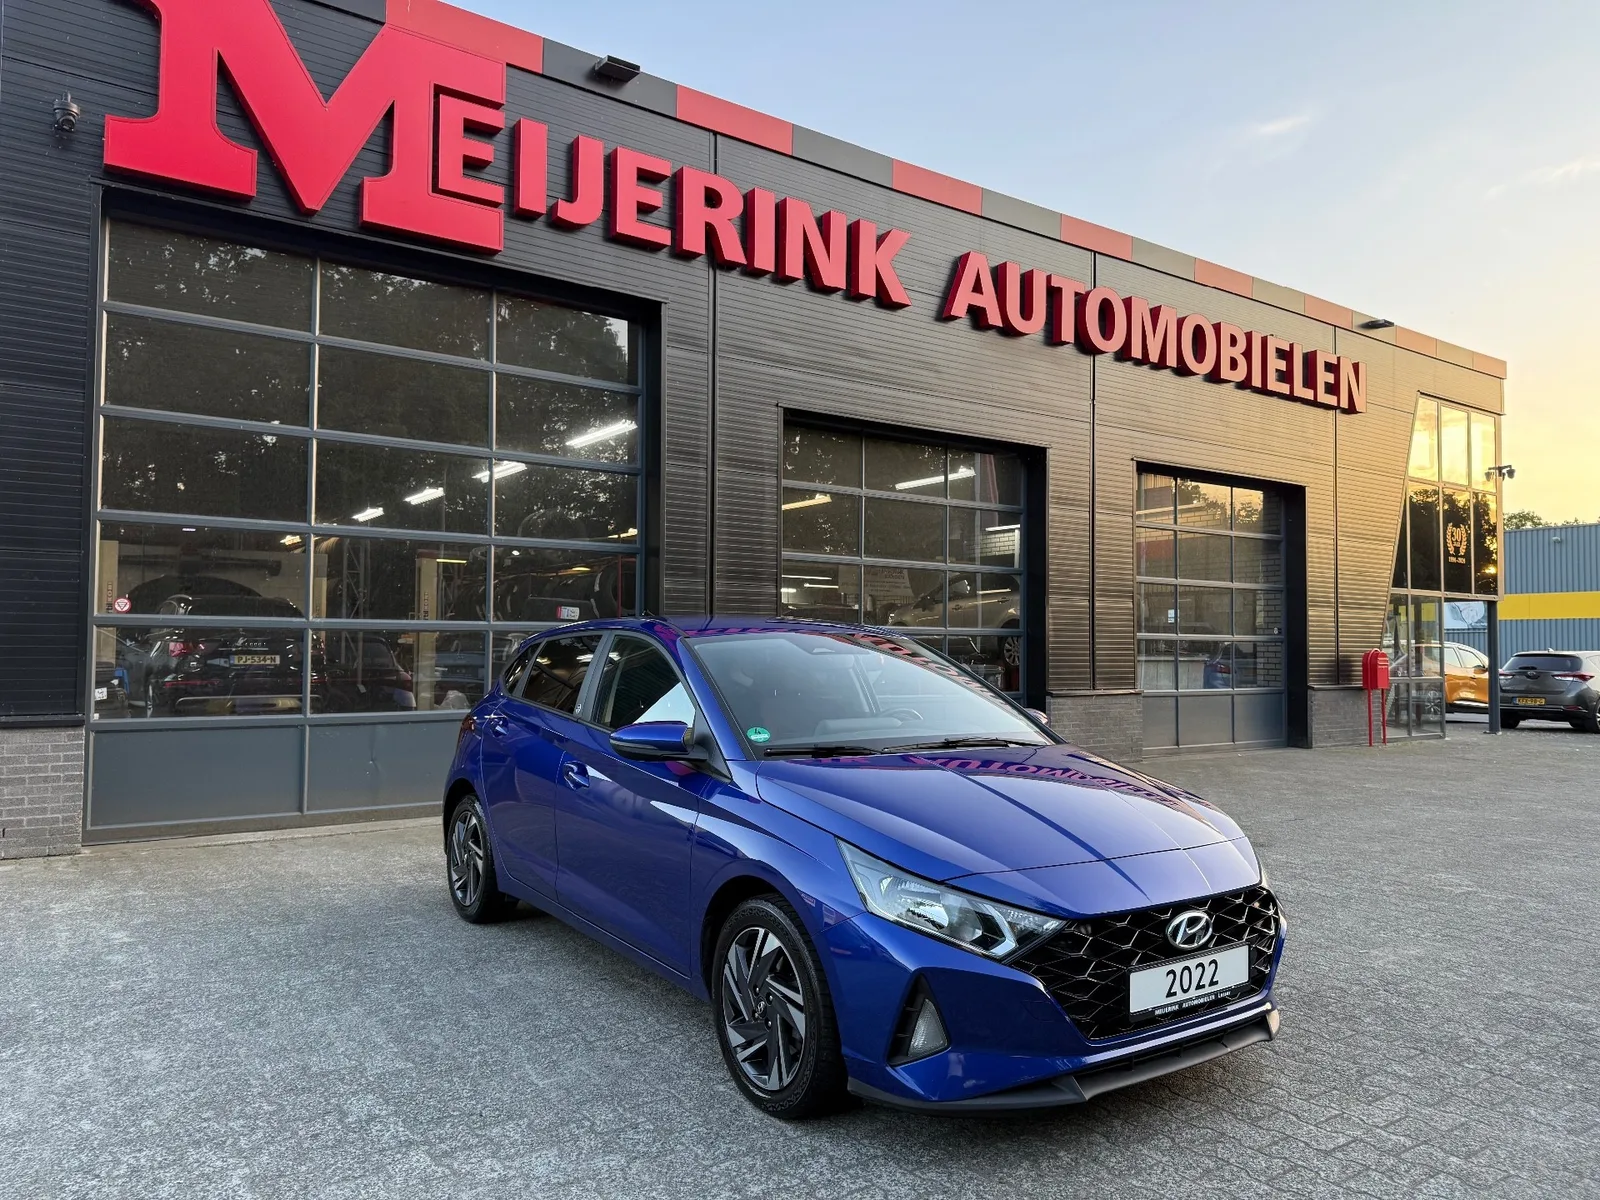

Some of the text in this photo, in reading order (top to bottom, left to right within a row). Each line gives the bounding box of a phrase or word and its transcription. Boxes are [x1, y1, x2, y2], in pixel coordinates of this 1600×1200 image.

[103, 0, 1367, 414] MEIJERINK AUTOMOBIELEN
[237, 655, 277, 665] PJ-534-N
[1165, 959, 1219, 998] 2022
